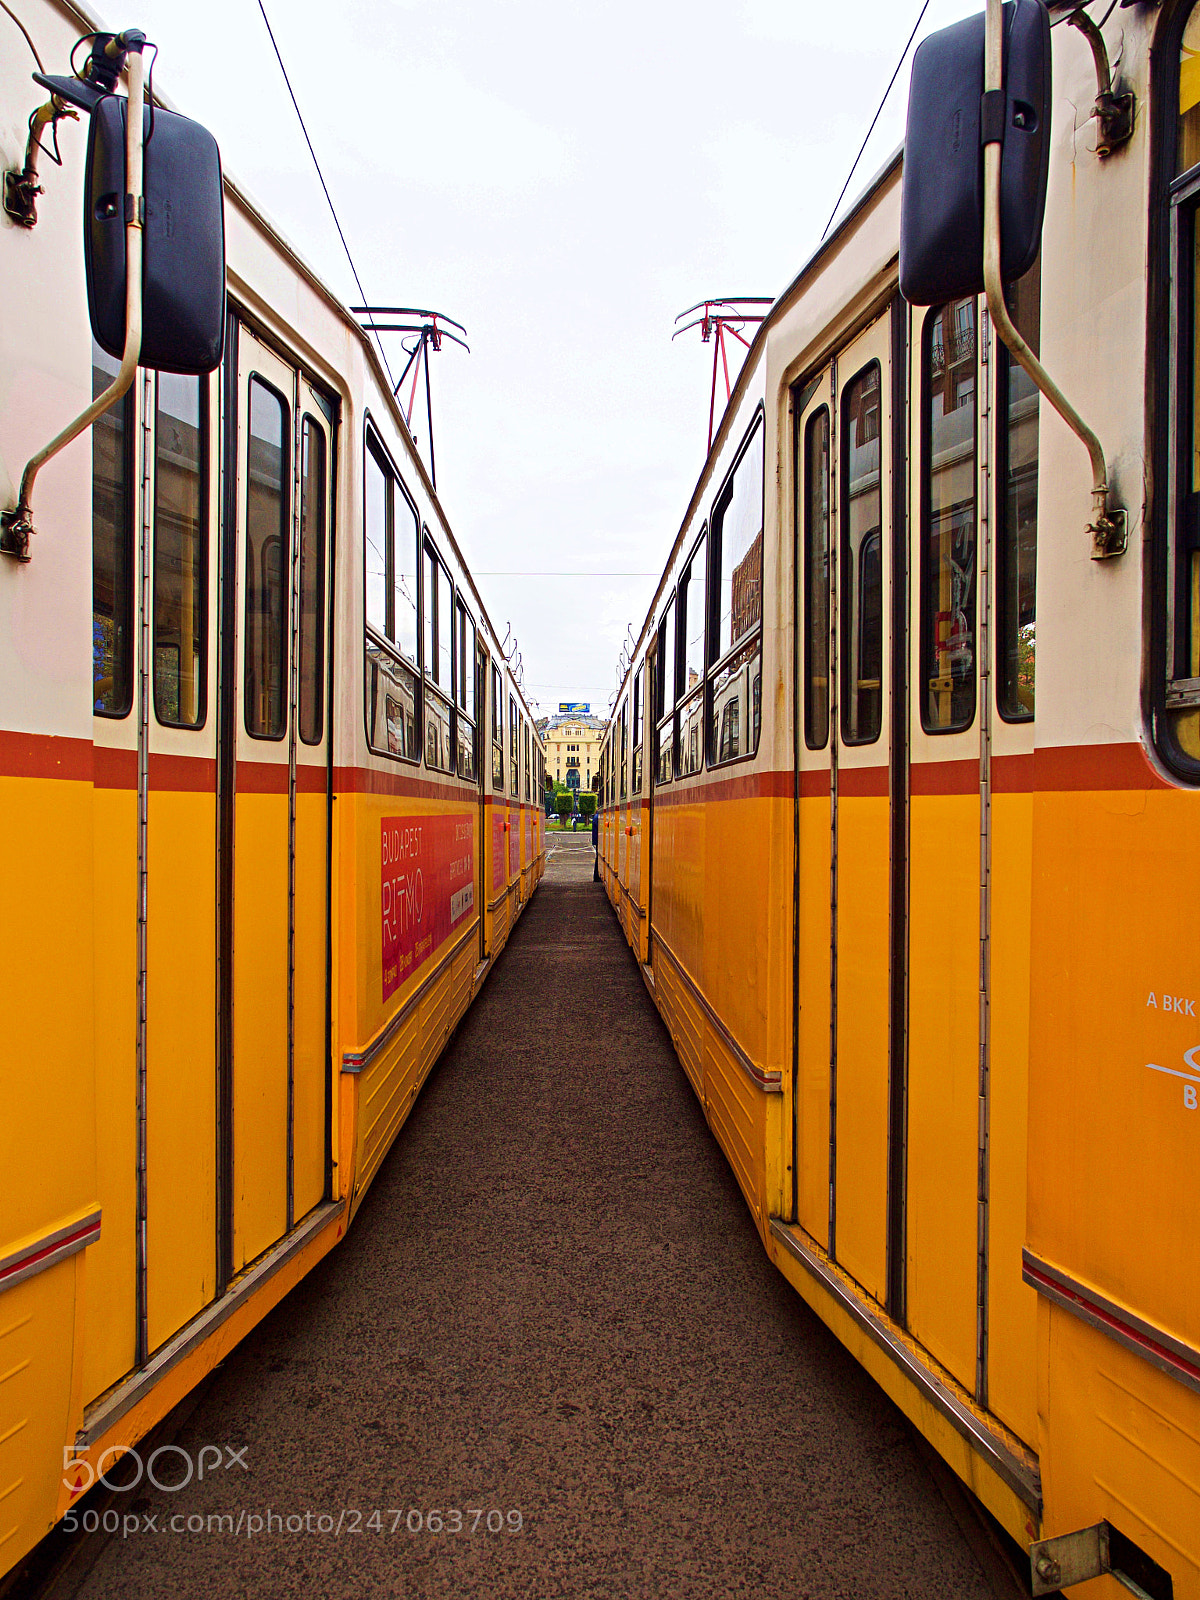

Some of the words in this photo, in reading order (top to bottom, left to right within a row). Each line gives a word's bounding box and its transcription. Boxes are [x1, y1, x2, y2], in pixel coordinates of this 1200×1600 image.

[383, 827, 422, 866] BUDAPEST
[1147, 992, 1158, 1009] A
[1163, 995, 1196, 1017] BKK
